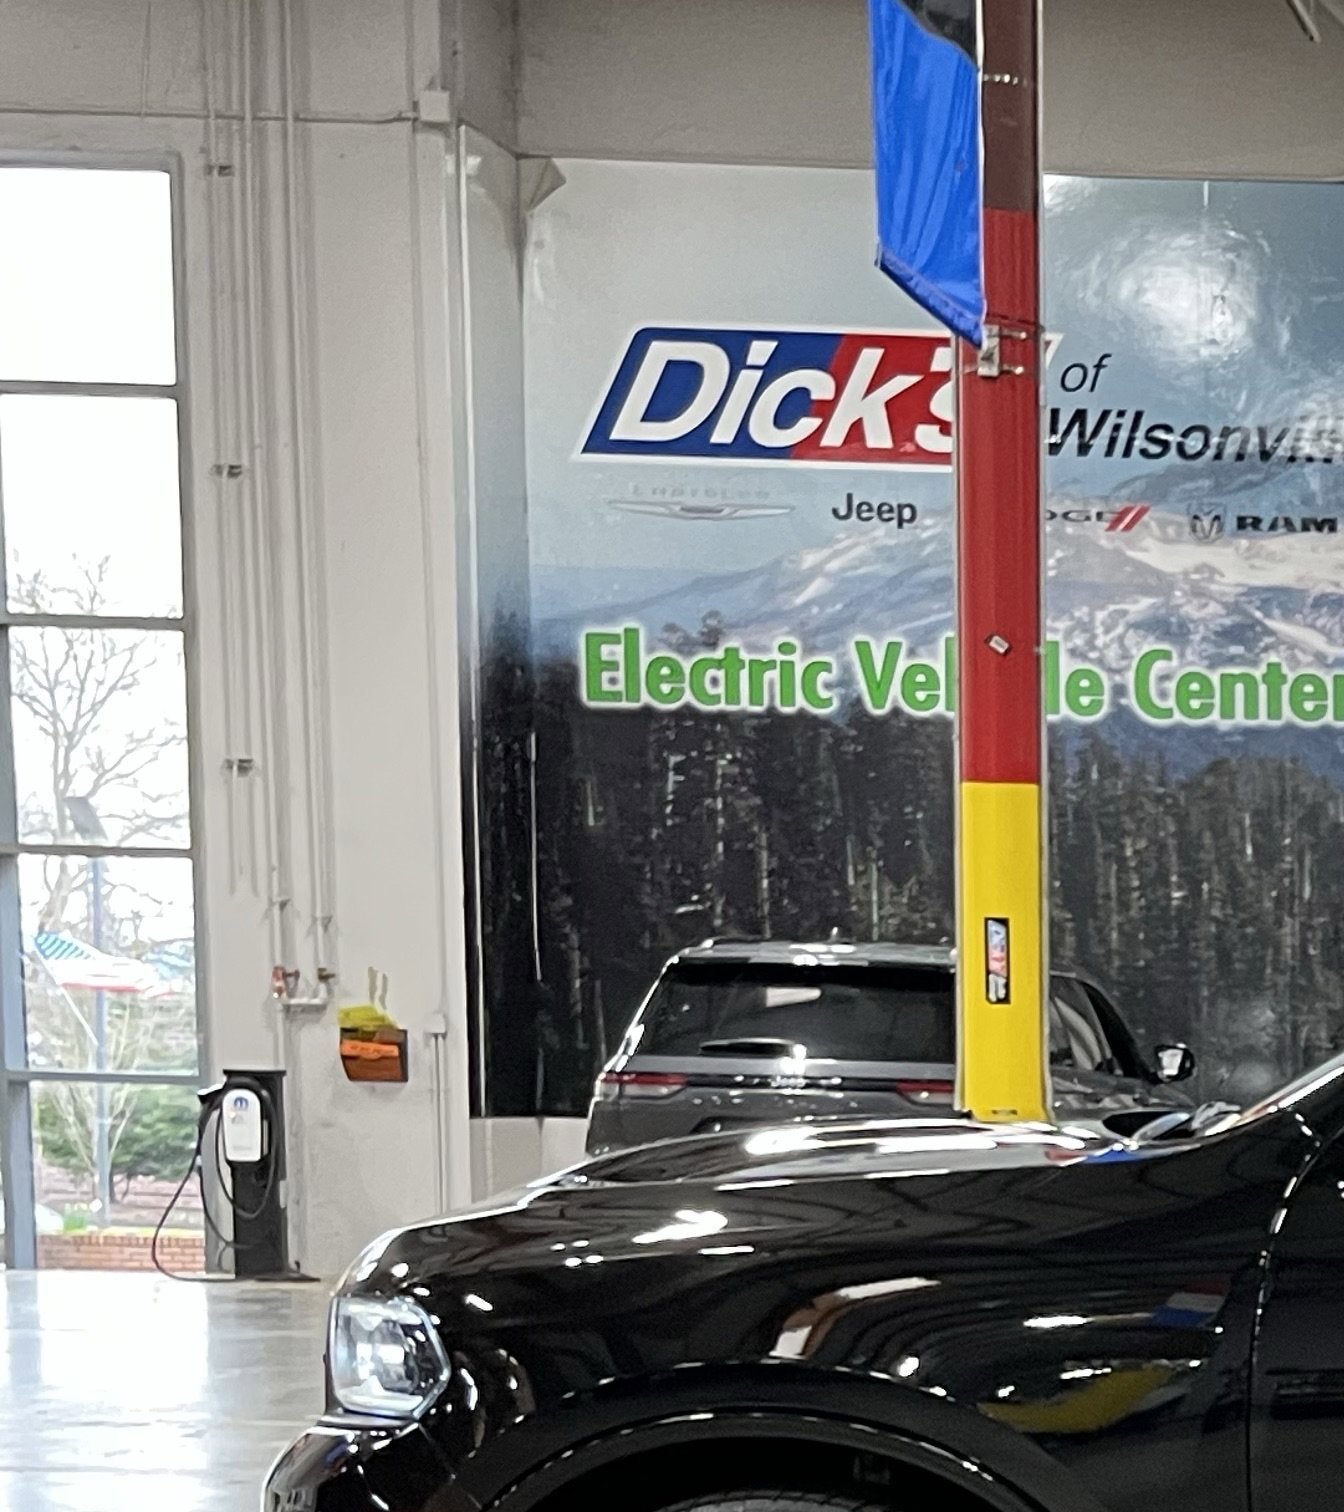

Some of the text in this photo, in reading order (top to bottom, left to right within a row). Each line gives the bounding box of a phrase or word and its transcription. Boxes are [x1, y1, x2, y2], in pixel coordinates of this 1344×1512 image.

[1060, 353, 1112, 393] of
[831, 492, 918, 530] Jeep
[1236, 516, 1338, 533] RAM
[585, 627, 834, 710] Electric
[854, 636, 1105, 717] Vele
